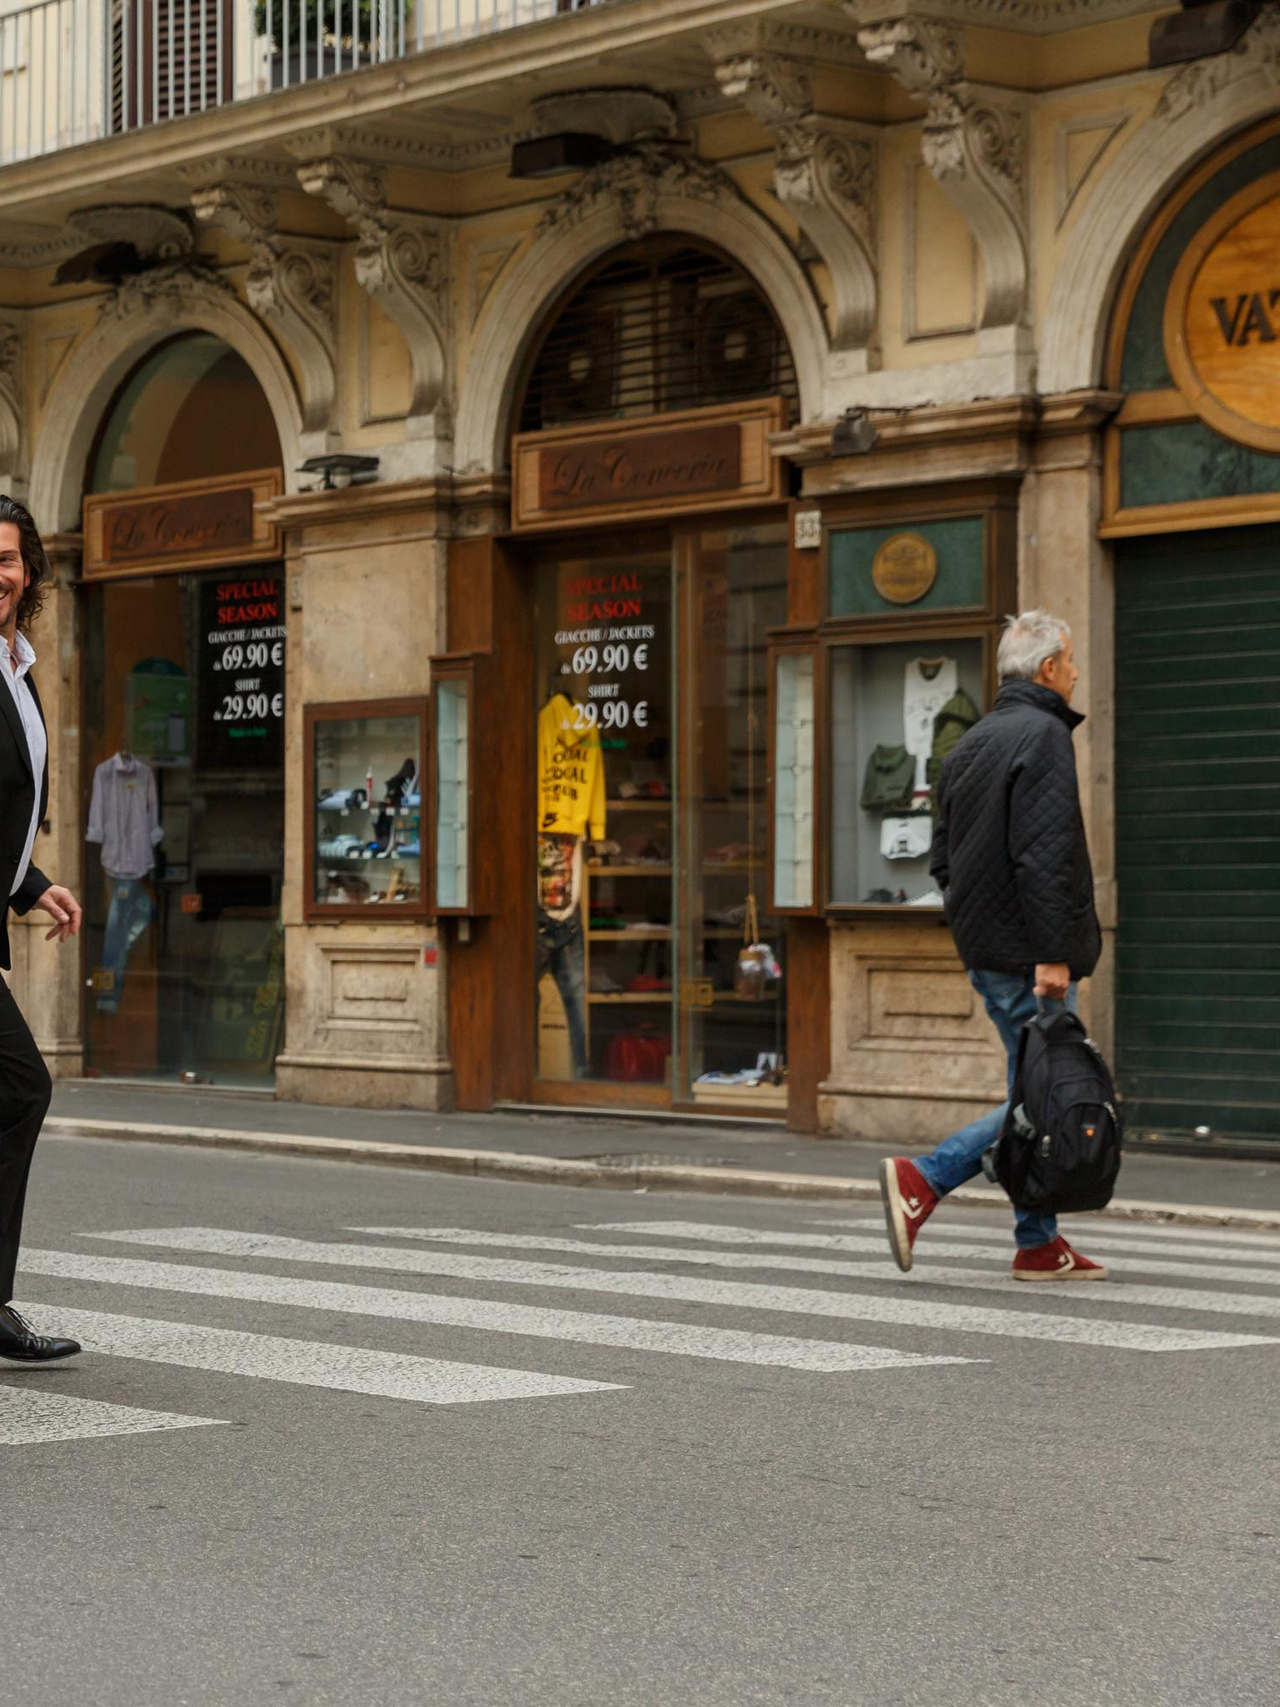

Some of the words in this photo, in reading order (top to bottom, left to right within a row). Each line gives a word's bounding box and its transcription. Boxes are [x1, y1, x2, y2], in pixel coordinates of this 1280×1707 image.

[216, 580, 278, 601] SPECIAL
[566, 572, 643, 597] SPECIAL
[218, 602, 278, 624] SEASON
[566, 600, 641, 622] SEASON
[208, 629, 246, 644] GIACCHE
[251, 625, 287, 641] JACKETS
[555, 630, 601, 645] GIACCHE
[608, 625, 655, 641] JACKETS
[222, 642, 268, 671] 69.90
[271, 642, 283, 667] €
[572, 643, 630, 675] 69.90
[633, 644, 648, 671] €
[235, 678, 260, 692] SHIRT
[588, 684, 619, 698] SHIRT
[222, 693, 268, 721] 29.90
[271, 693, 283, 717] €
[572, 700, 630, 730] 29.90
[633, 701, 648, 727] €
